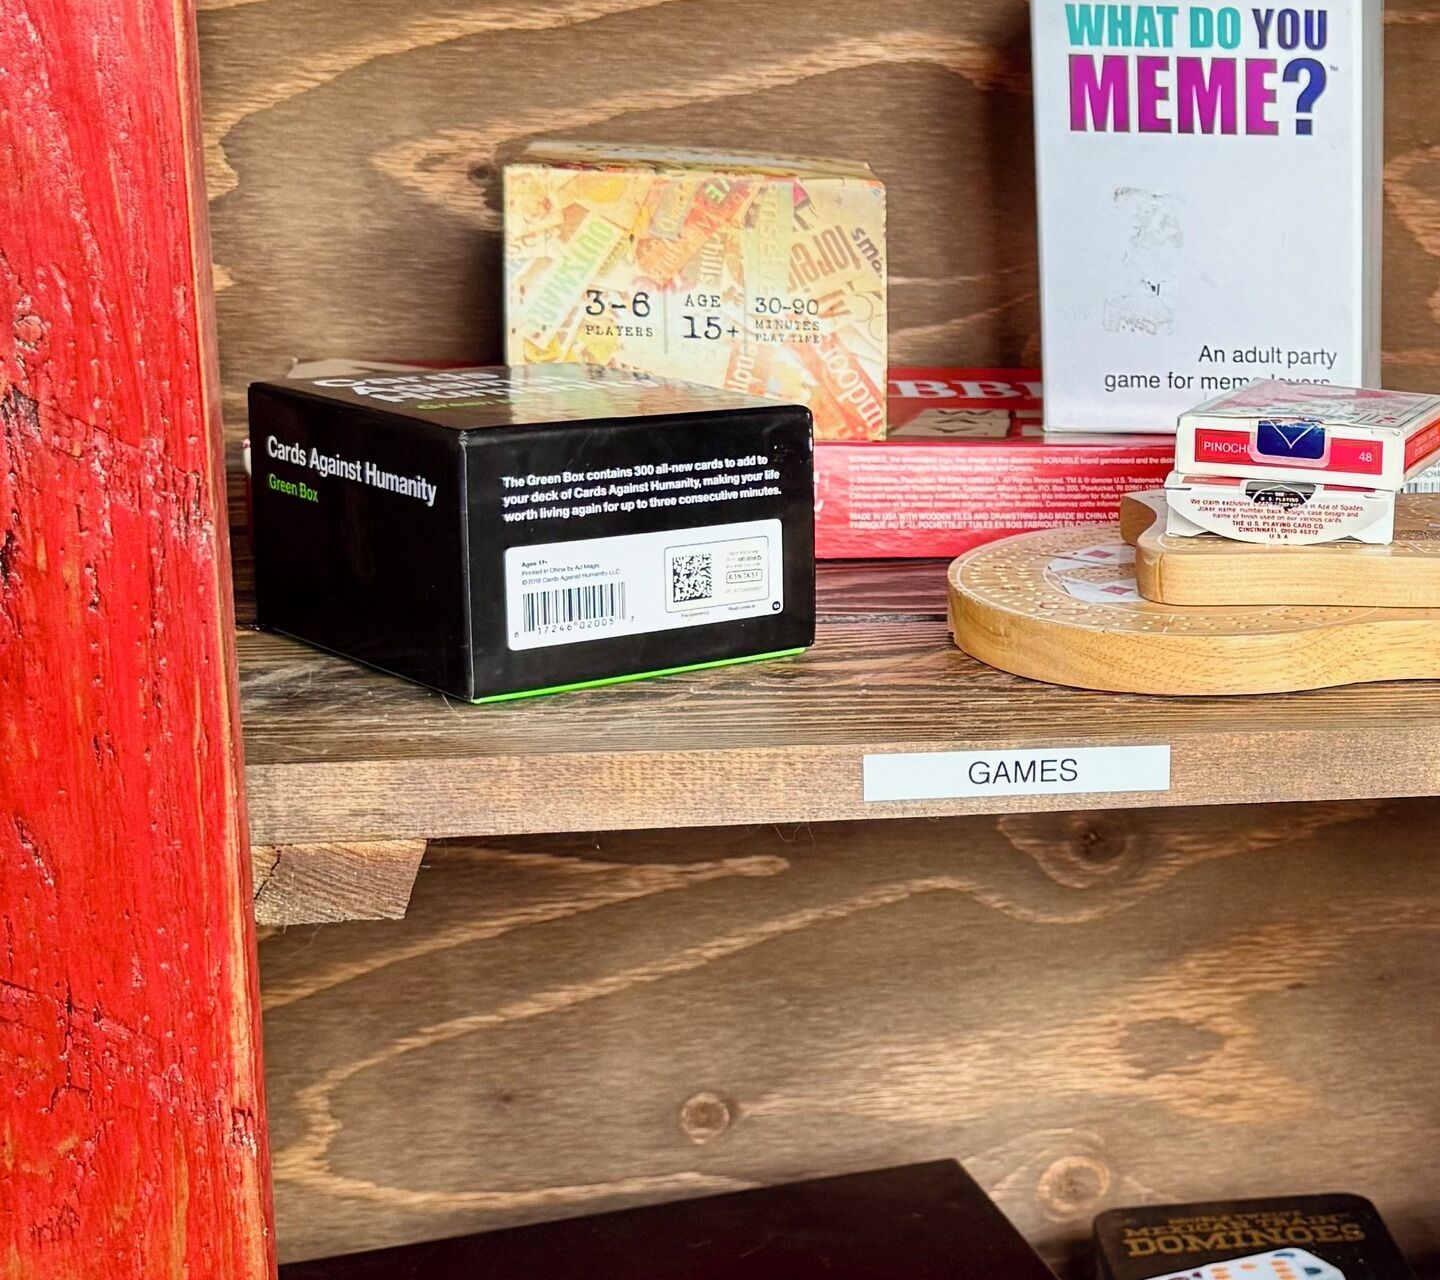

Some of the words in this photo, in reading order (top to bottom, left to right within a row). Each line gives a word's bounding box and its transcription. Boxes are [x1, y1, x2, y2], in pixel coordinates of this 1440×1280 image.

[1065, 3, 1179, 48] WHAT
[1189, 5, 1241, 50] DO
[1251, 8, 1328, 50] YOU
[1067, 53, 1328, 136] MEME?
[585, 289, 652, 318] 3-6
[685, 294, 721, 308] AGE
[755, 297, 819, 315] 30-90
[586, 325, 653, 338] PLAYERS
[683, 316, 739, 340] 15+
[755, 319, 820, 331] MINUTES
[755, 333, 784, 342] PLAY
[790, 334, 820, 343] TIME
[1198, 345, 1227, 364] An
[1231, 345, 1283, 364] adult
[1286, 348, 1337, 369] party
[1104, 374, 1161, 391] game
[1167, 372, 1194, 389] for
[1200, 376, 1258, 390] mem
[1100, 458, 1135, 466] gameboard
[1358, 452, 1372, 462] 48
[267, 435, 307, 467] Cards
[309, 448, 362, 482] Against
[365, 461, 437, 507] Humanity
[502, 476, 524, 488] The
[527, 473, 561, 487] Green
[563, 471, 584, 484] Box
[586, 467, 633, 481] contains
[634, 464, 654, 476] 300
[655, 461, 693, 475] all-new
[695, 458, 723, 471] cards
[724, 457, 735, 468] to
[736, 455, 756, 467] add
[757, 455, 768, 466] to
[268, 473, 297, 496] Green
[299, 482, 319, 503] Box
[503, 494, 529, 508] your
[530, 489, 559, 503] deck
[560, 487, 572, 501] of
[573, 485, 607, 499] Cards
[608, 481, 649, 498] Against
[651, 478, 701, 492] Humanity,
[703, 473, 740, 488] making
[741, 472, 763, 485] your
[764, 469, 780, 481] life
[504, 507, 538, 522] worth
[539, 504, 570, 519] living
[571, 503, 602, 517] again
[603, 500, 619, 513] for
[621, 500, 635, 512] up
[636, 498, 647, 509] to
[649, 495, 677, 508] three
[678, 490, 739, 506] consecutive
[740, 486, 781, 499] minutes.
[919, 512, 951, 521] WOODEN
[974, 512, 990, 521] AND
[1038, 512, 1053, 520] BAG
[1054, 512, 1074, 520] MADE
[1076, 512, 1084, 520] IN
[1085, 512, 1107, 520] CHINA
[1109, 512, 1118, 520] OR
[542, 576, 559, 584] Cards
[582, 570, 608, 578] Humanity
[550, 566, 566, 574] China
[967, 758, 1079, 785] GAMES
[1123, 1222, 1366, 1257] DOMINOES
